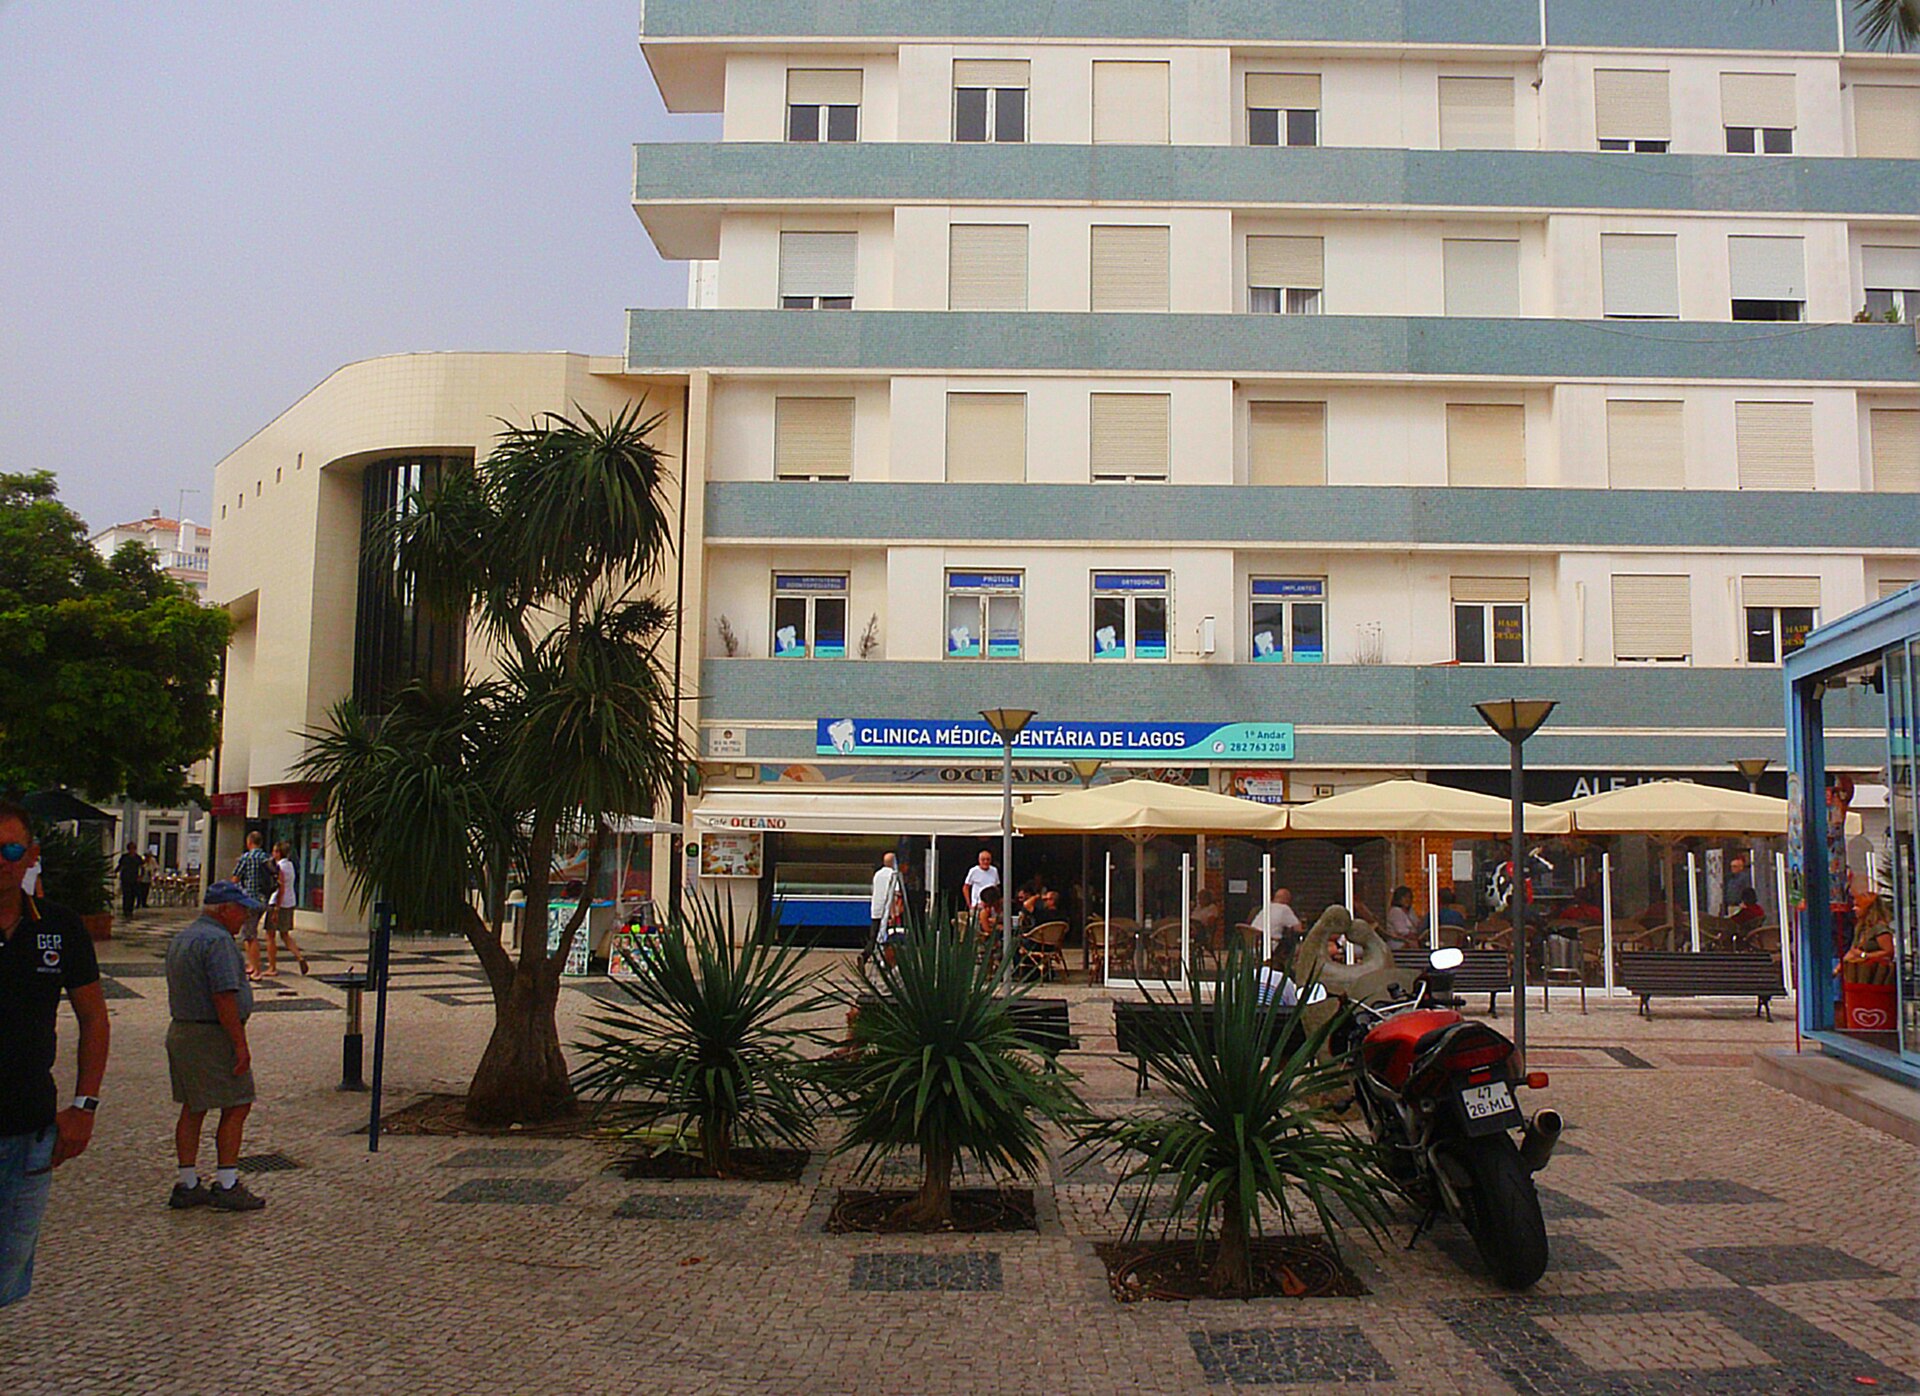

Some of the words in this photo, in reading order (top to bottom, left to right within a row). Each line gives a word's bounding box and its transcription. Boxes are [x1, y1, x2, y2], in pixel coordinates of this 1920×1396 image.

[1282, 584, 1317, 592] IMPLANTES
[1497, 619, 1519, 627] HAIR
[1785, 624, 1809, 634] HAIR
[860, 727, 932, 744] CLINICA
[935, 725, 1004, 745] MÉDICA
[1099, 731, 1124, 747] DE
[1127, 731, 1186, 748] LAGOS
[1257, 729, 1287, 740] Andar
[1230, 742, 1248, 752] 282
[1248, 742, 1267, 752] 763
[1269, 742, 1287, 753] 208
[938, 766, 1075, 784] OCEANO
[730, 816, 788, 830] OCEANO
[36, 933, 63, 950] GER
[1477, 1086, 1491, 1099] 47
